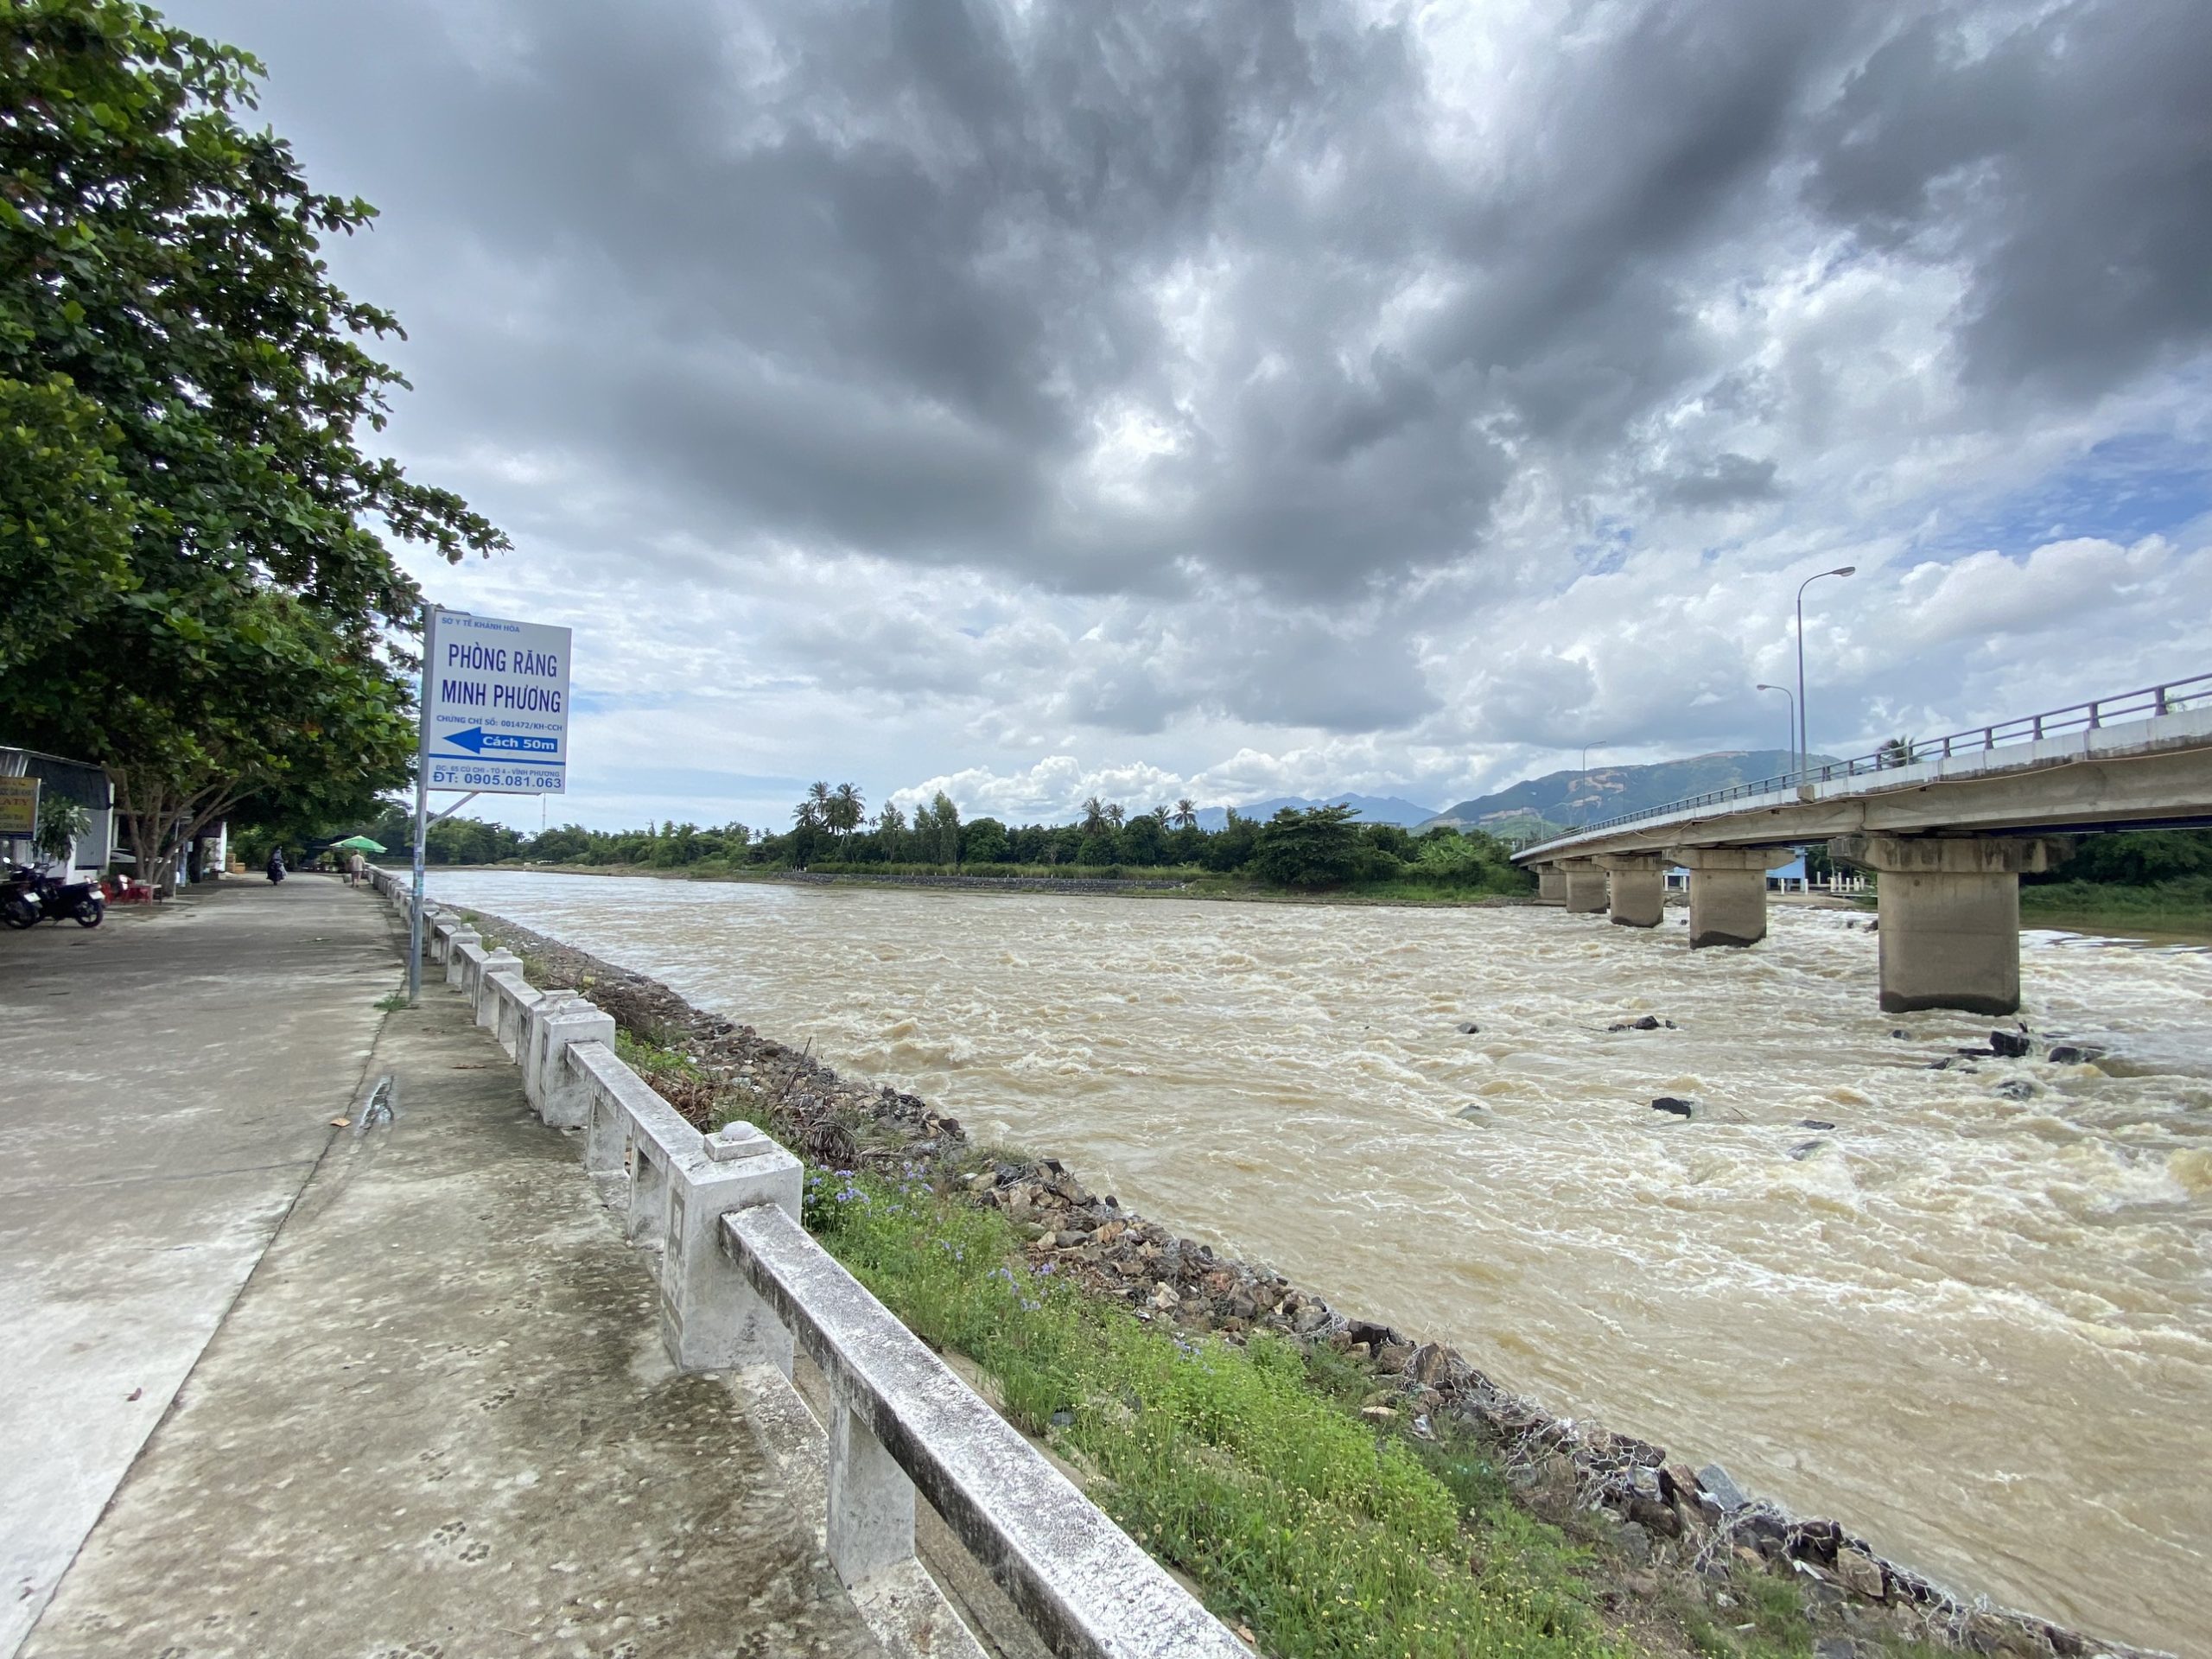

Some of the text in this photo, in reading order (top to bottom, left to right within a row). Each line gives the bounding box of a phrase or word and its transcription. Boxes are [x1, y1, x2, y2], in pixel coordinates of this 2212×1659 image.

[448, 642, 557, 677] PHÒNG RĂNG
[442, 679, 561, 713] MINH PHƯƠNG
[482, 736, 555, 750] Cách 50m
[433, 772, 562, 788] ĐT: 0905.081.063
